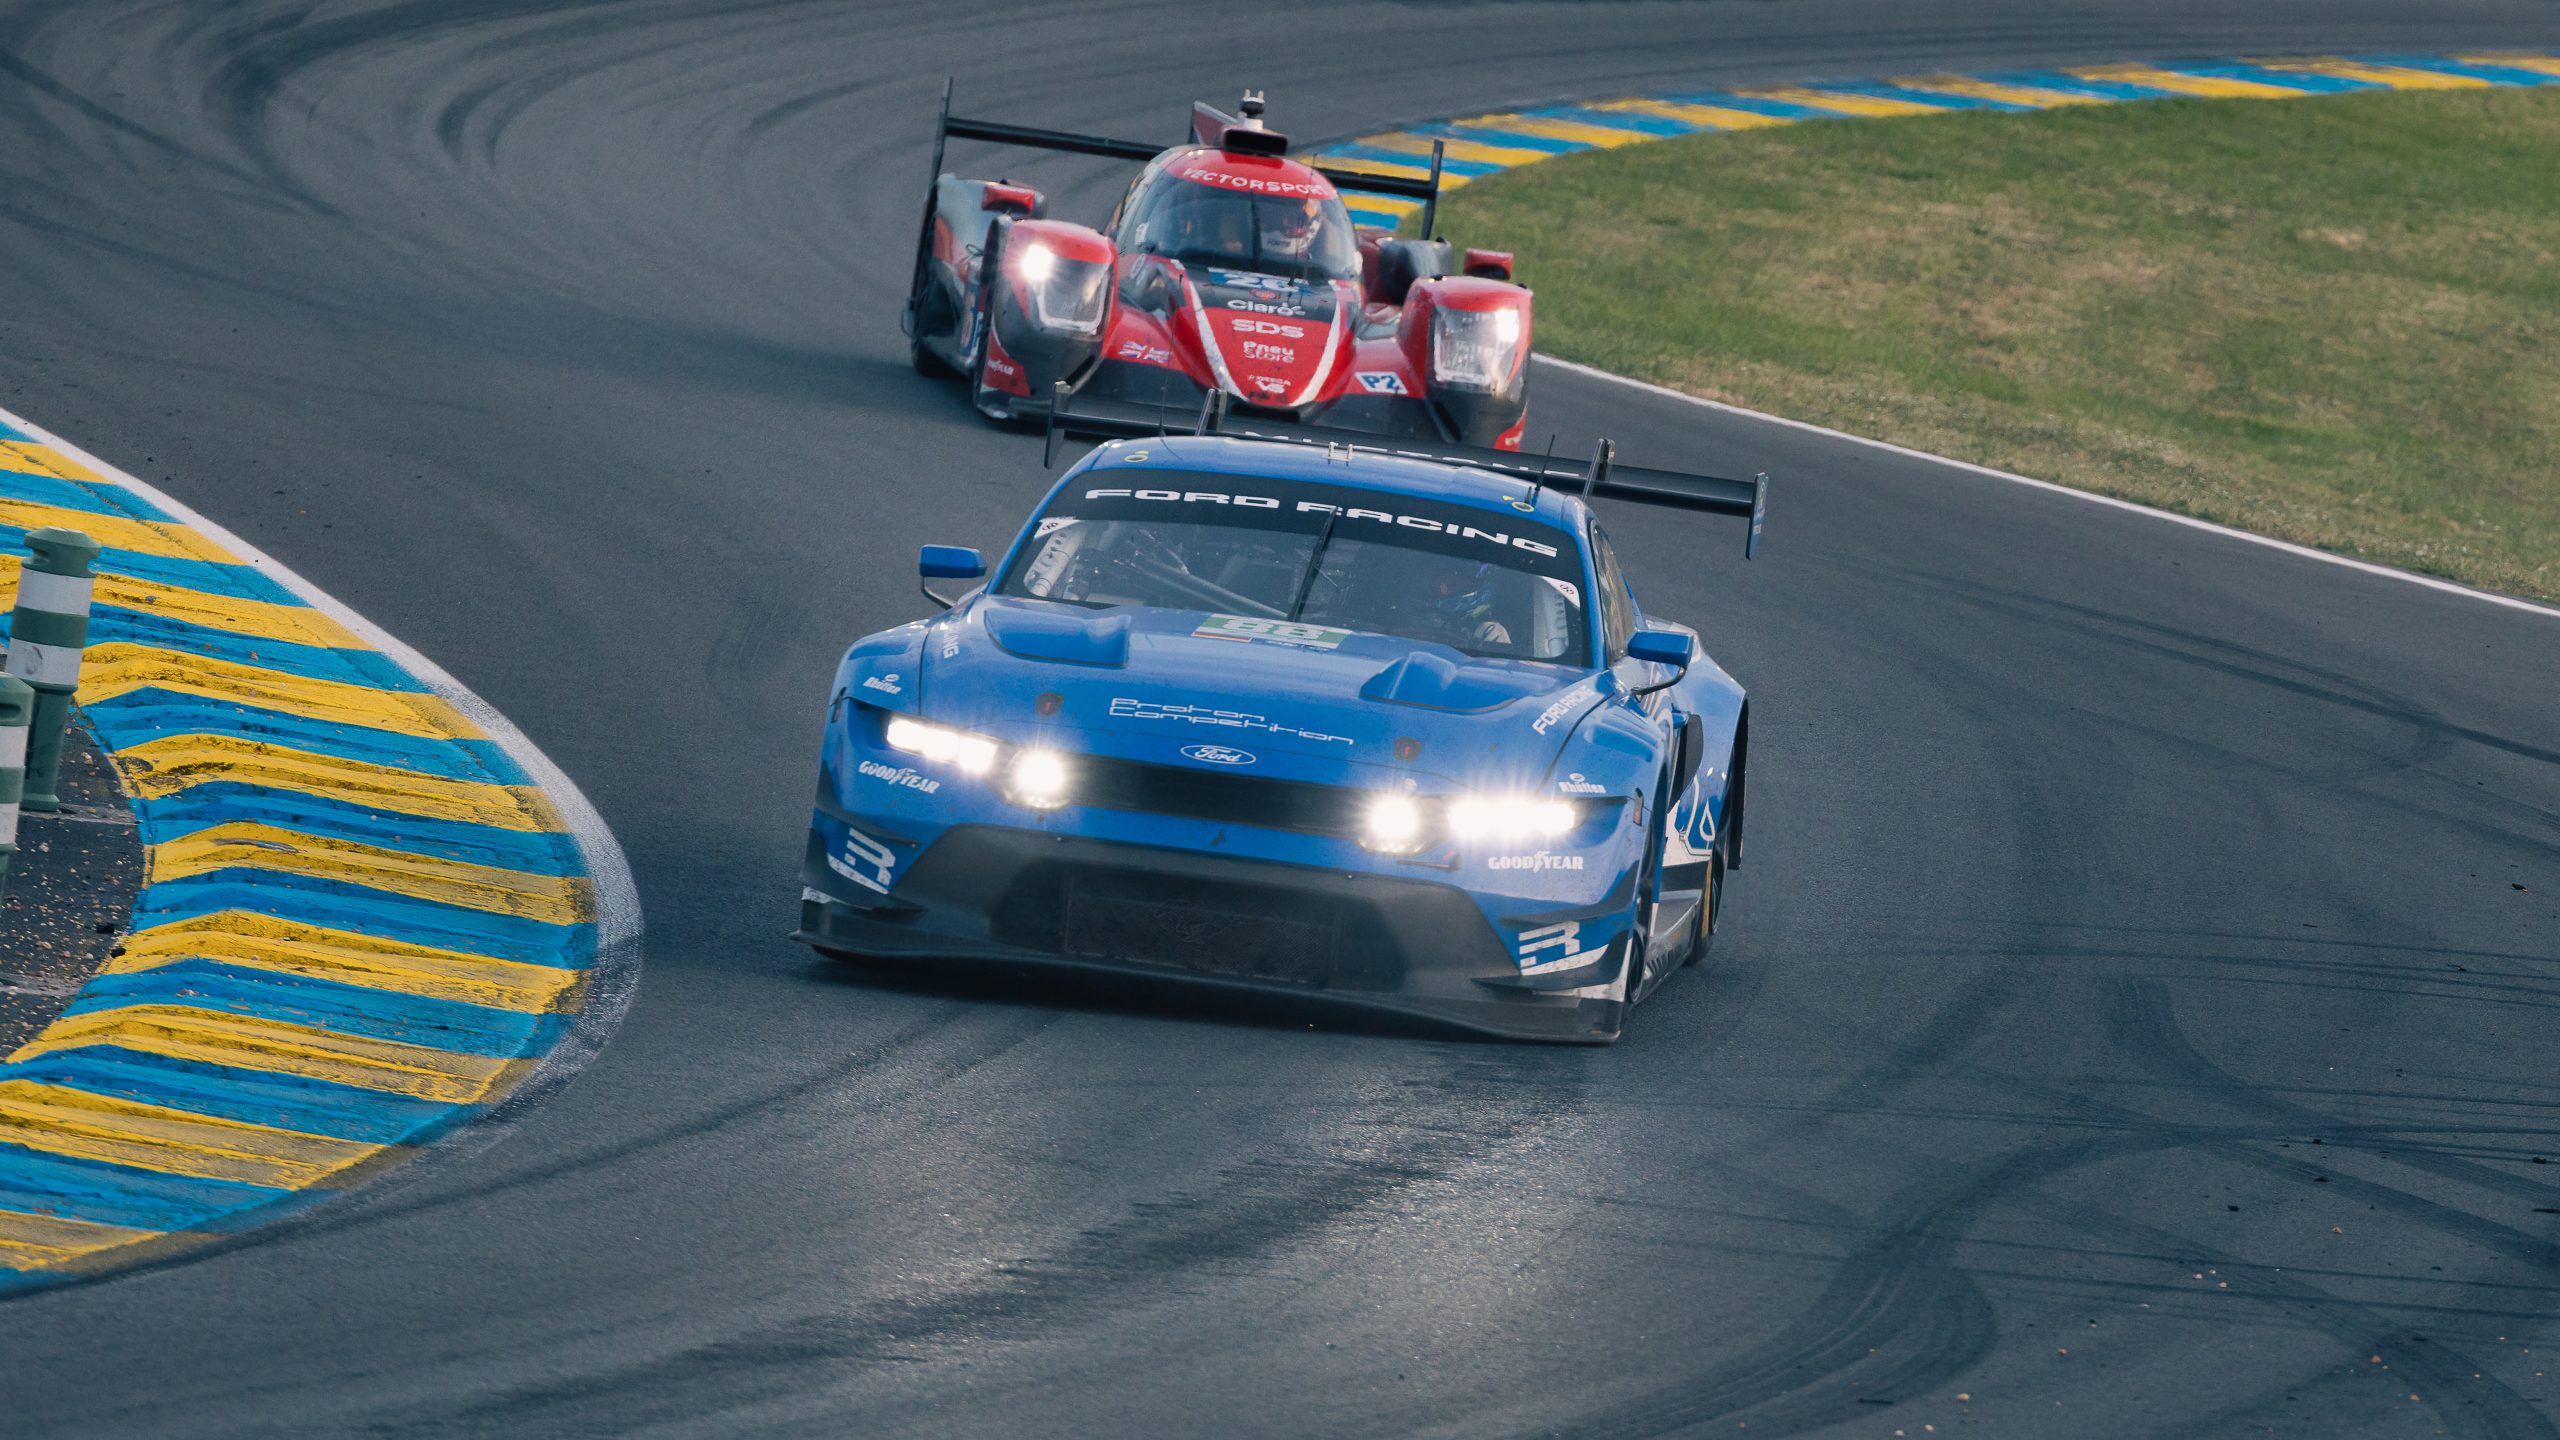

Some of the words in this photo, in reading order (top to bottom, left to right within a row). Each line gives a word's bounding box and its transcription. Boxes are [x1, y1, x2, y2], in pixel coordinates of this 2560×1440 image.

[1232, 319, 1304, 338] SDS
[1243, 341, 1294, 356] Pneu
[1243, 349, 1294, 363] Store
[1360, 374, 1399, 390] P2
[1085, 489, 1280, 509] FORD
[1296, 501, 1558, 557] RACING
[1110, 698, 1265, 721] Proton
[1532, 702, 1570, 736] FORD
[1109, 706, 1354, 745] Competition
[1194, 745, 1242, 762] Ford
[858, 760, 940, 794] GOODYEAR
[1488, 851, 1583, 873] GOODYEAR
